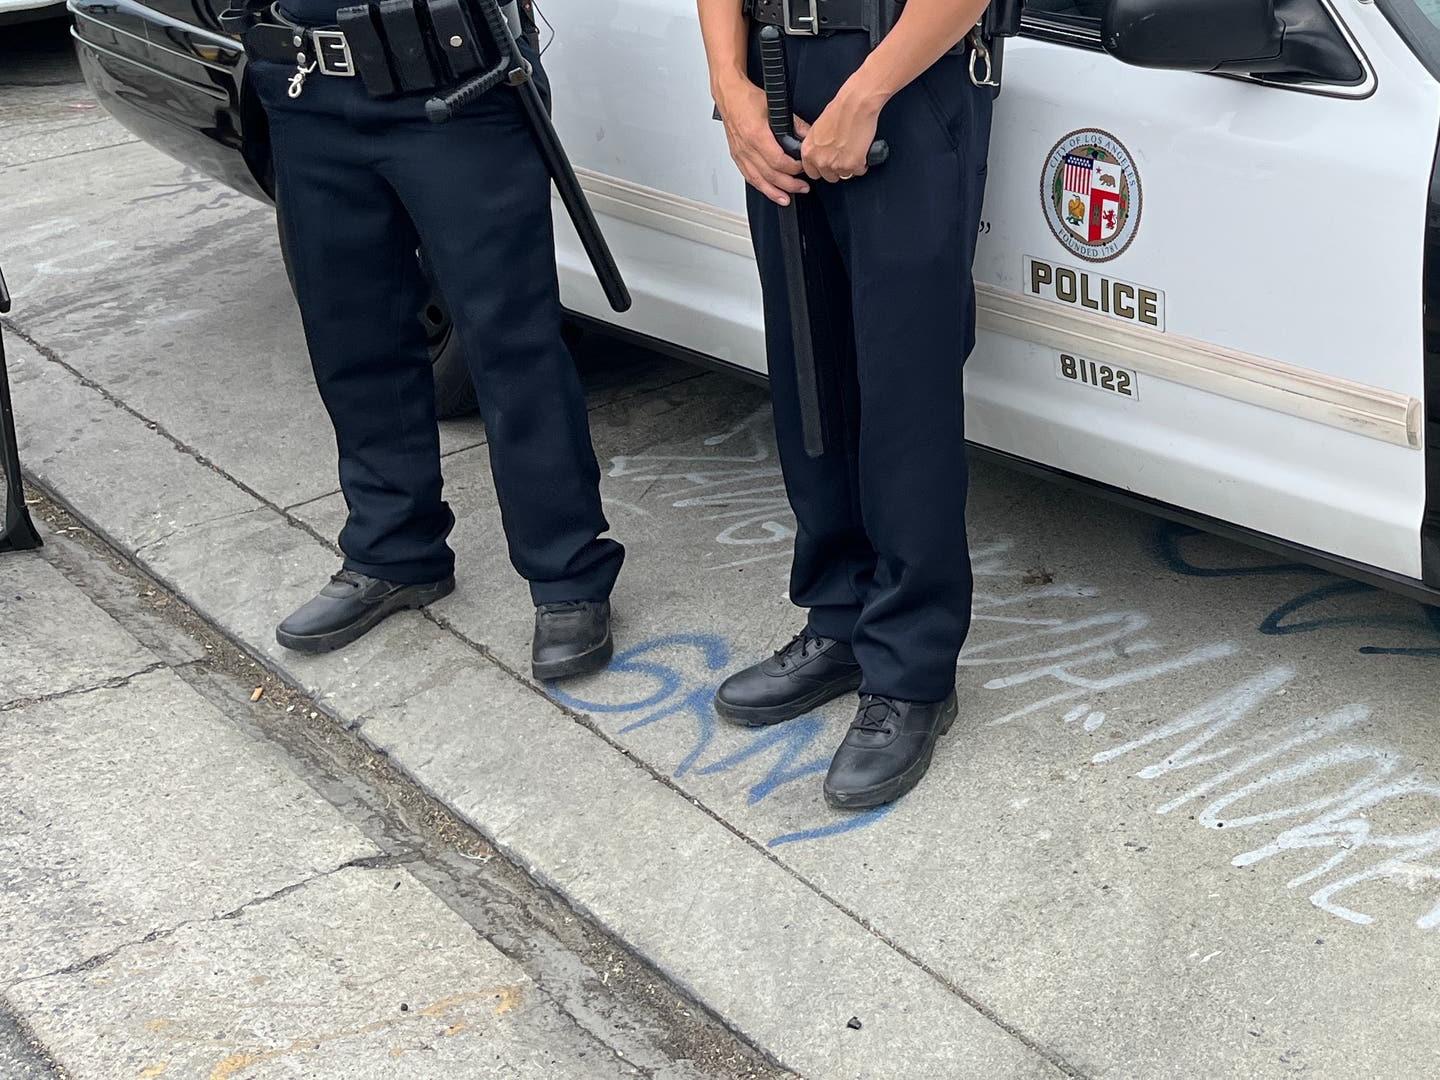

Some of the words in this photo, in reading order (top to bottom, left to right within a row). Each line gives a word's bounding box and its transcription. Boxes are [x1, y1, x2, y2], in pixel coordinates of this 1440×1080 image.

[1050, 145, 1067, 168] CITY
[1069, 136, 1081, 147] OF
[1085, 134, 1102, 144] LOS
[1104, 141, 1136, 187] ANGELES
[1058, 228, 1099, 257] FOUNDED
[1101, 243, 1119, 257] 1781
[1030, 259, 1158, 326] POLICE
[1059, 353, 1132, 396] 81122
